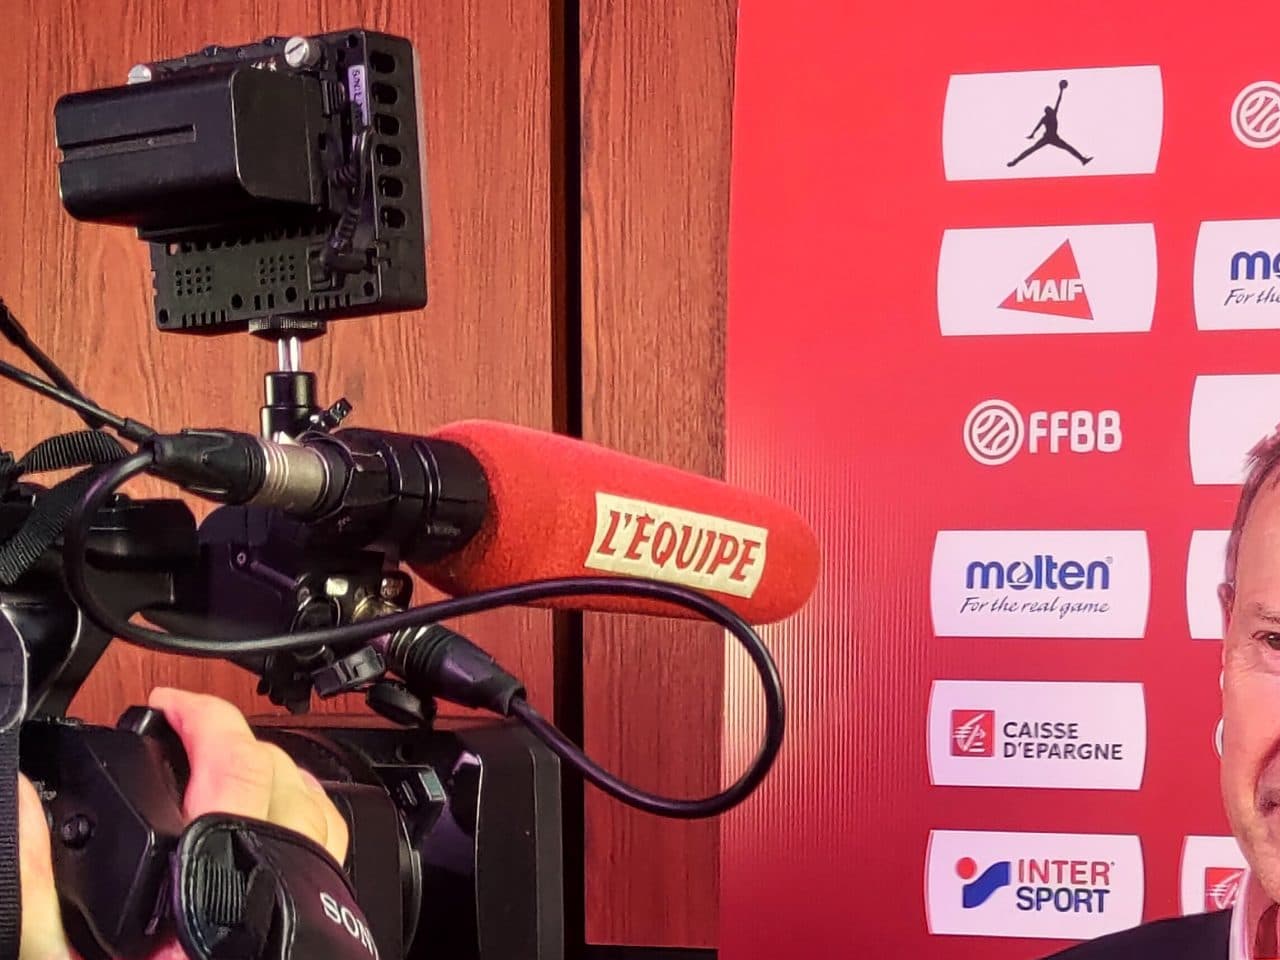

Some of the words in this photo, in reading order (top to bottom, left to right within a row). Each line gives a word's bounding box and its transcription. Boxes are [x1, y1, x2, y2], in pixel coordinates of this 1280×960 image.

[1015, 278, 1084, 303] MAIF
[1224, 287, 1254, 306] For
[1028, 409, 1123, 454] FFBB
[597, 508, 761, 582] L'ÉQUIPE
[966, 555, 1110, 590] molten
[960, 596, 988, 613] For
[991, 595, 1017, 613] the
[1019, 596, 1060, 613] real
[1059, 602, 1110, 619] game
[1003, 721, 1079, 740] CAISSE
[1003, 740, 1123, 761] D'EPARGNE
[1018, 859, 1111, 886] INTER
[1015, 886, 1110, 914] SPORT
